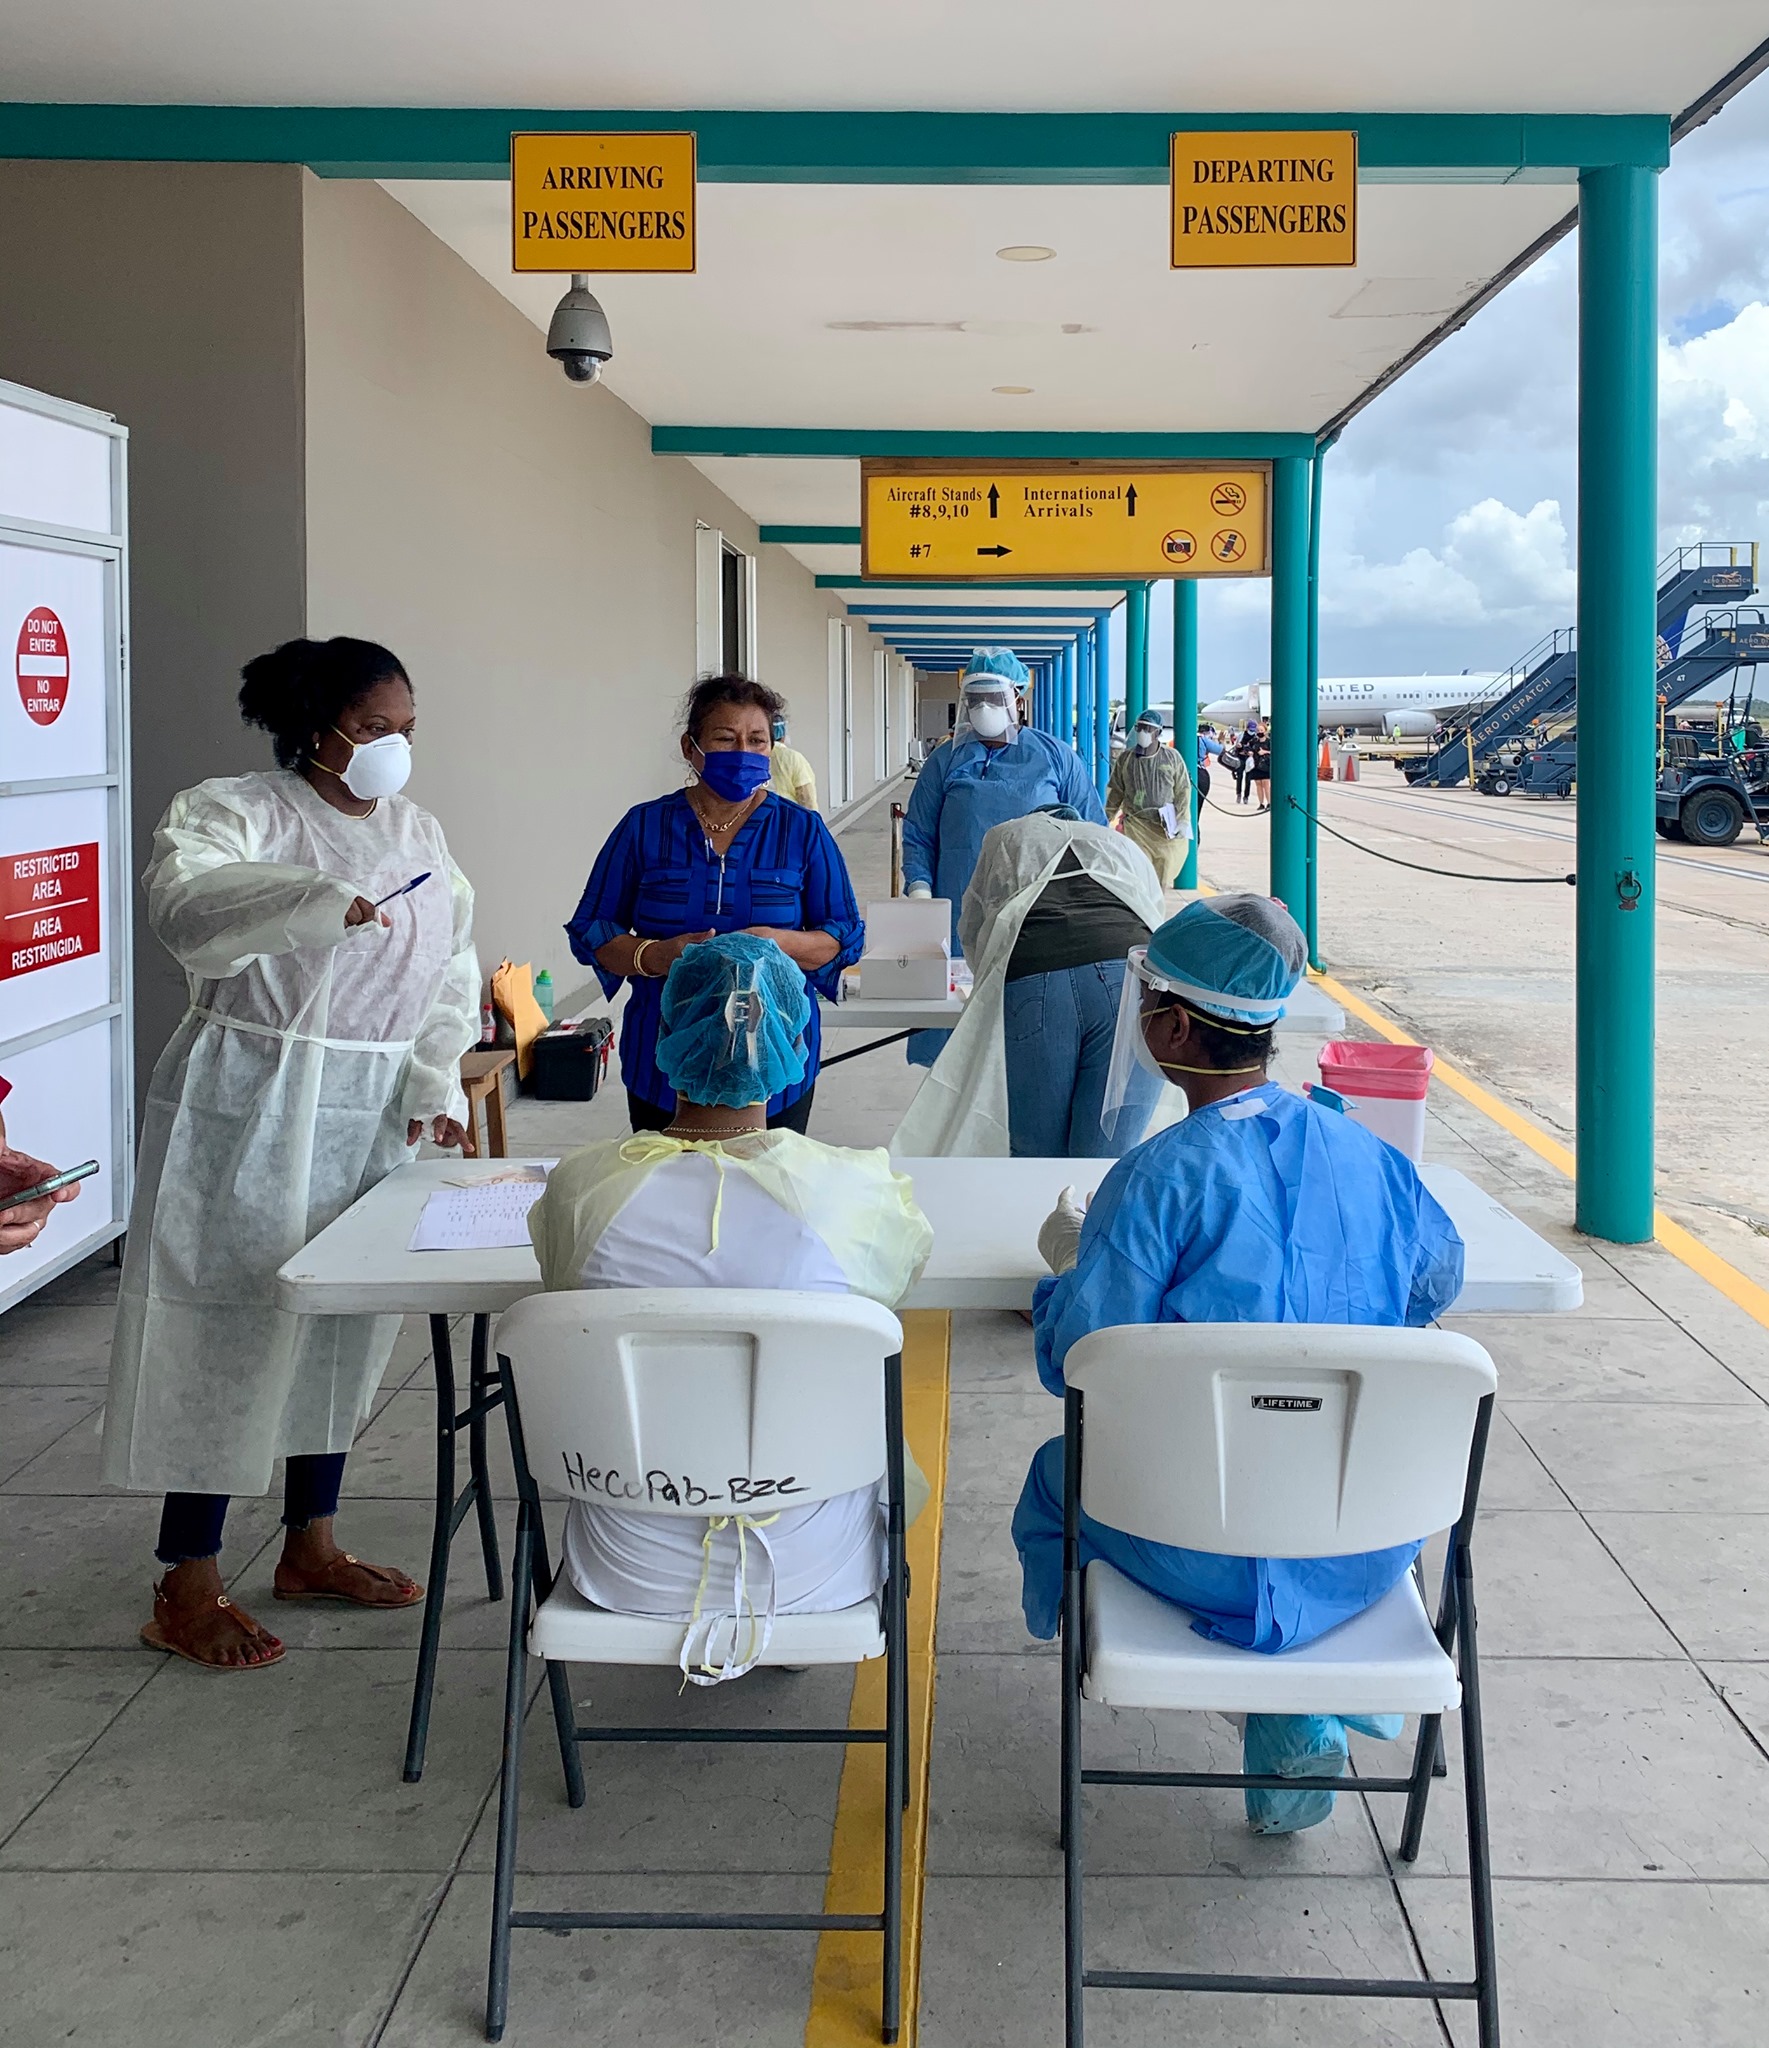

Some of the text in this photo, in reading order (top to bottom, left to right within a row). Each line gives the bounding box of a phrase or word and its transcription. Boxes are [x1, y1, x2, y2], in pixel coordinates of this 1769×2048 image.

[541, 165, 664, 190] ARRIVING
[1192, 158, 1335, 184] DEPARTING
[522, 210, 686, 240] PASSENGERS
[1182, 203, 1347, 235] PASSENGERS
[887, 487, 983, 501] Aircraft Stands
[1023, 486, 1122, 501] International
[909, 504, 970, 521] #8,9,10
[1023, 503, 1094, 518] Arrivals
[909, 543, 932, 558] #7
[27, 619, 59, 635] DO NOT
[29, 638, 57, 653] ENTER
[36, 680, 50, 694] NO
[1317, 684, 1375, 693] NITED
[27, 698, 61, 713] ENTRAR
[1471, 677, 1552, 748] AERO DISPATCH
[13, 851, 80, 880] RESTRICTED
[31, 878, 63, 902] AREA
[31, 915, 63, 940] AREA
[11, 934, 83, 971] RESTRINGIDA
[1257, 1397, 1313, 1409] LIFETIME
